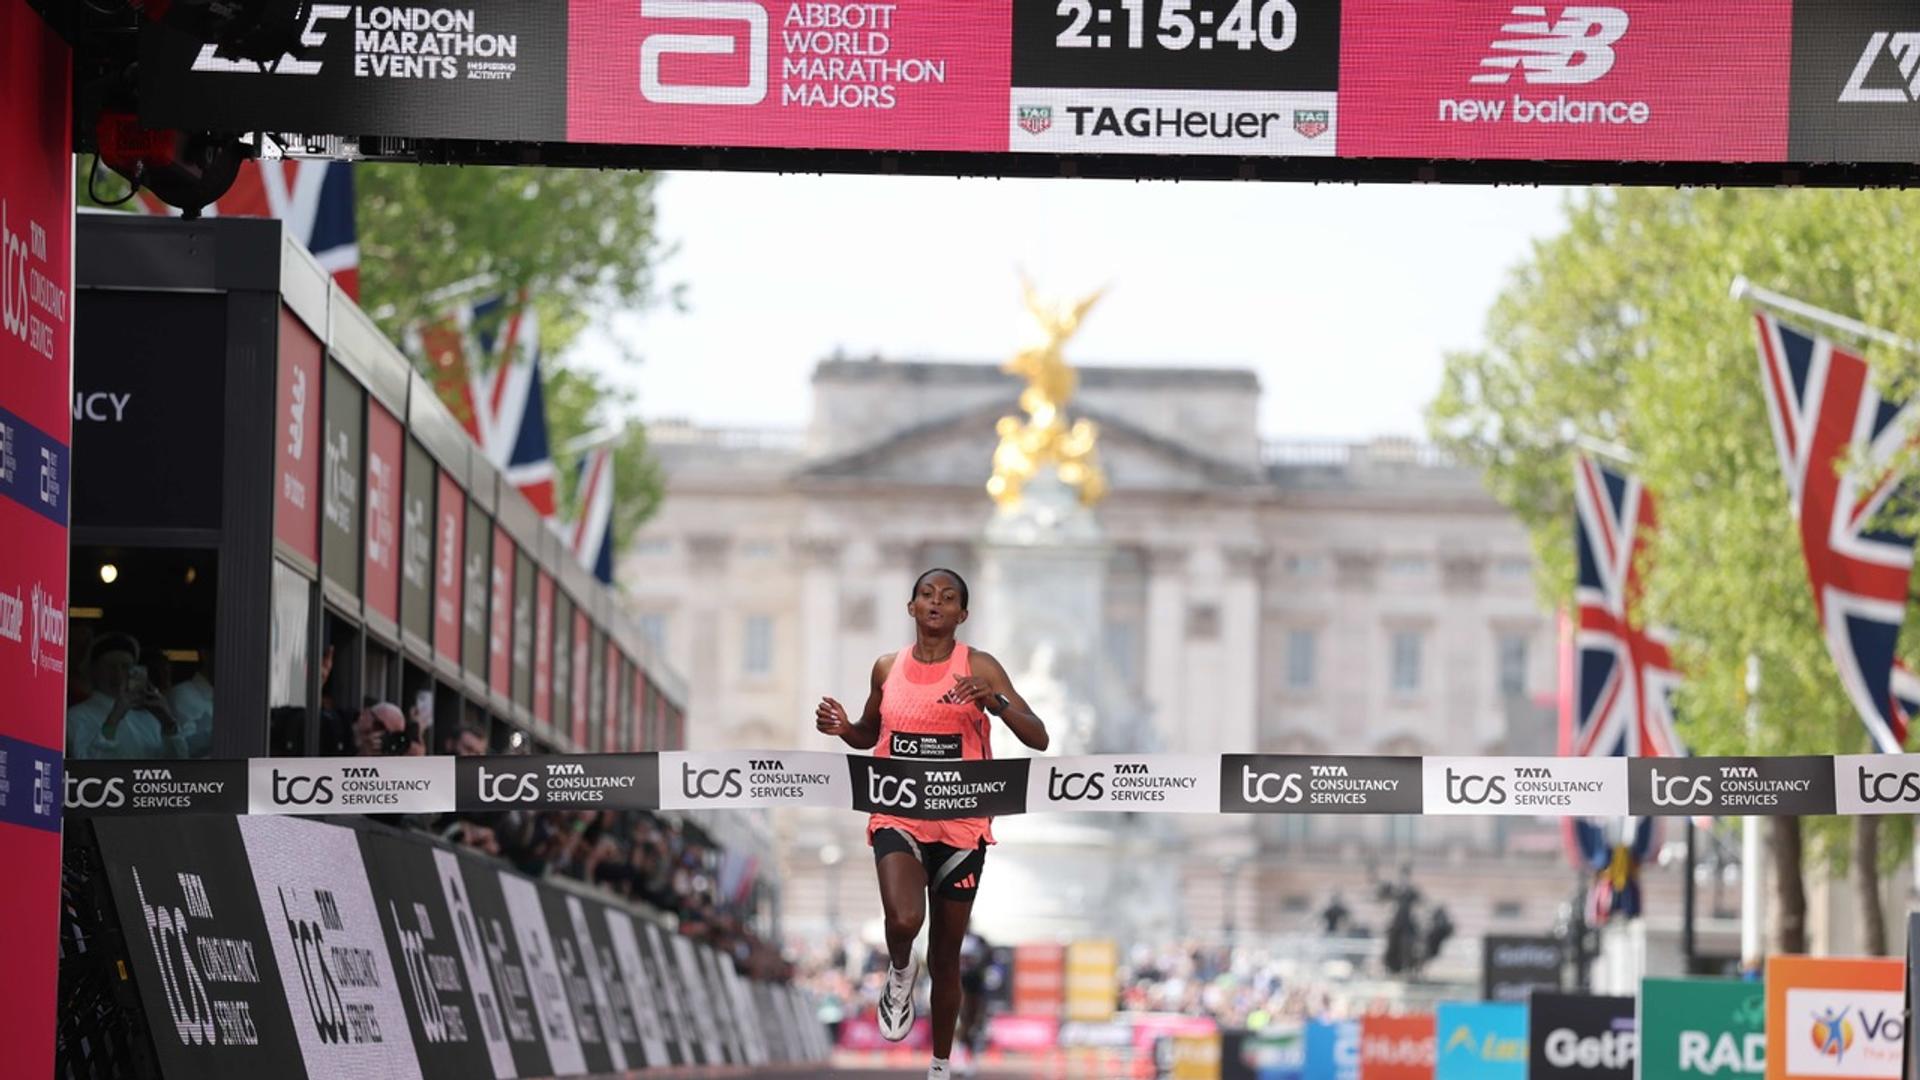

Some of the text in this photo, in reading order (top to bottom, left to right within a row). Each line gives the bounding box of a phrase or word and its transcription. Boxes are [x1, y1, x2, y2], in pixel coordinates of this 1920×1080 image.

[354, 7, 475, 33] LONDON
[783, 3, 896, 29] ABBOTT
[1056, 0, 1297, 50] 2:15:40
[354, 31, 517, 58] MARATHON
[783, 31, 889, 54] WORLD
[354, 54, 458, 79] EVENTS
[467, 61, 516, 71] INSPIRING
[782, 57, 945, 83] MARATHON
[467, 70, 512, 80] ACTIVITY
[782, 84, 896, 108] MAJORS
[1020, 108, 1049, 118] TAG
[1439, 94, 1650, 124] new balance
[1296, 111, 1326, 122] TAG
[3, 199, 28, 342] tcs
[893, 735, 918, 755] tcs
[546, 764, 585, 775] TATA
[749, 760, 784, 771] TATA
[1113, 764, 1149, 775] TATA
[1310, 765, 1348, 777] TATA
[133, 769, 172, 780] TATA
[342, 768, 380, 778] TATA
[749, 772, 830, 785] CONSULTANCY
[924, 771, 962, 782] TATA
[1514, 767, 1552, 778] TATA
[1720, 767, 1758, 779] TATA
[272, 768, 333, 805] tcs
[342, 780, 431, 792] CONSULTANCY
[478, 766, 540, 802] tcs
[546, 776, 636, 789] CONSULTANCY
[682, 761, 743, 799] tcs
[1048, 767, 1105, 801] tcs
[1112, 776, 1197, 789] CONSULTANCY
[1242, 765, 1303, 804] tcs
[1310, 778, 1399, 792] CONSULTANCY
[1446, 767, 1506, 805] tcs
[1514, 780, 1603, 793] CONSULTANCY
[1720, 780, 1811, 792] CONSULTANCY
[63, 770, 125, 808] tcs
[132, 781, 225, 794] CONSULTANCY
[749, 785, 804, 798] SERVICES
[867, 766, 917, 809] tcs
[924, 781, 1007, 797] CONSULTANCY
[1651, 768, 1713, 806] tcs
[133, 795, 191, 808] SERVICES
[342, 793, 399, 805] SERVICES
[546, 789, 604, 802] SERVICES
[1111, 789, 1165, 801] SERVICES
[1310, 792, 1367, 805] SERVICES
[1514, 794, 1572, 806] SERVICES
[1720, 793, 1778, 806] SERVICES
[924, 796, 978, 811] SERVICES
[177, 872, 214, 920] TATA
[132, 866, 216, 1045] tcs
[196, 937, 260, 983] CONSULTANCY
[278, 886, 349, 1044] tcs
[213, 1000, 258, 1045] SERVICES
